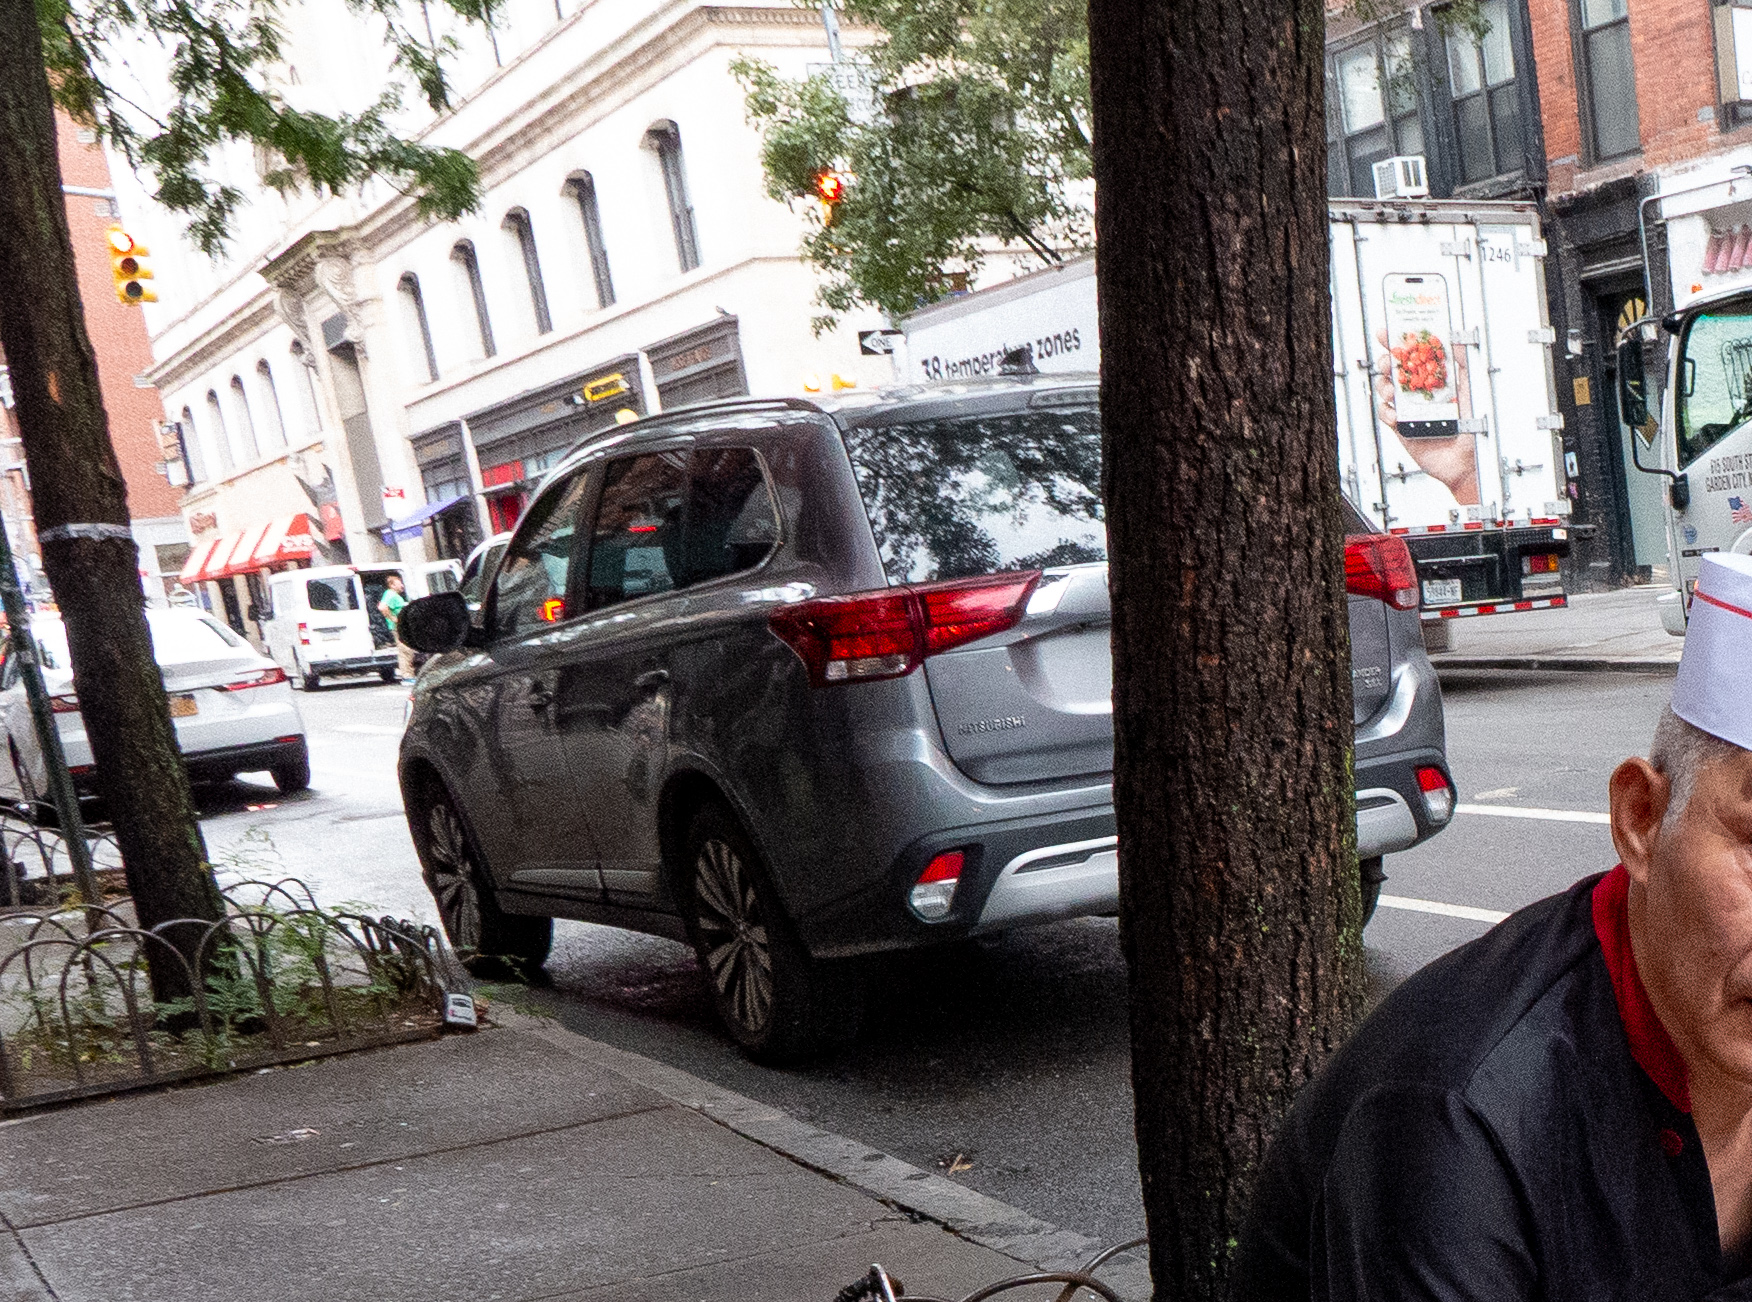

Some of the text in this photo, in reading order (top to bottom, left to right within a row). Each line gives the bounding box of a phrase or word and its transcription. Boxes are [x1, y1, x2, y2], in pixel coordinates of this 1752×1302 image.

[1481, 246, 1511, 263] 1246
[1036, 328, 1081, 360] zones
[958, 715, 1026, 735] MITSUBISHI
